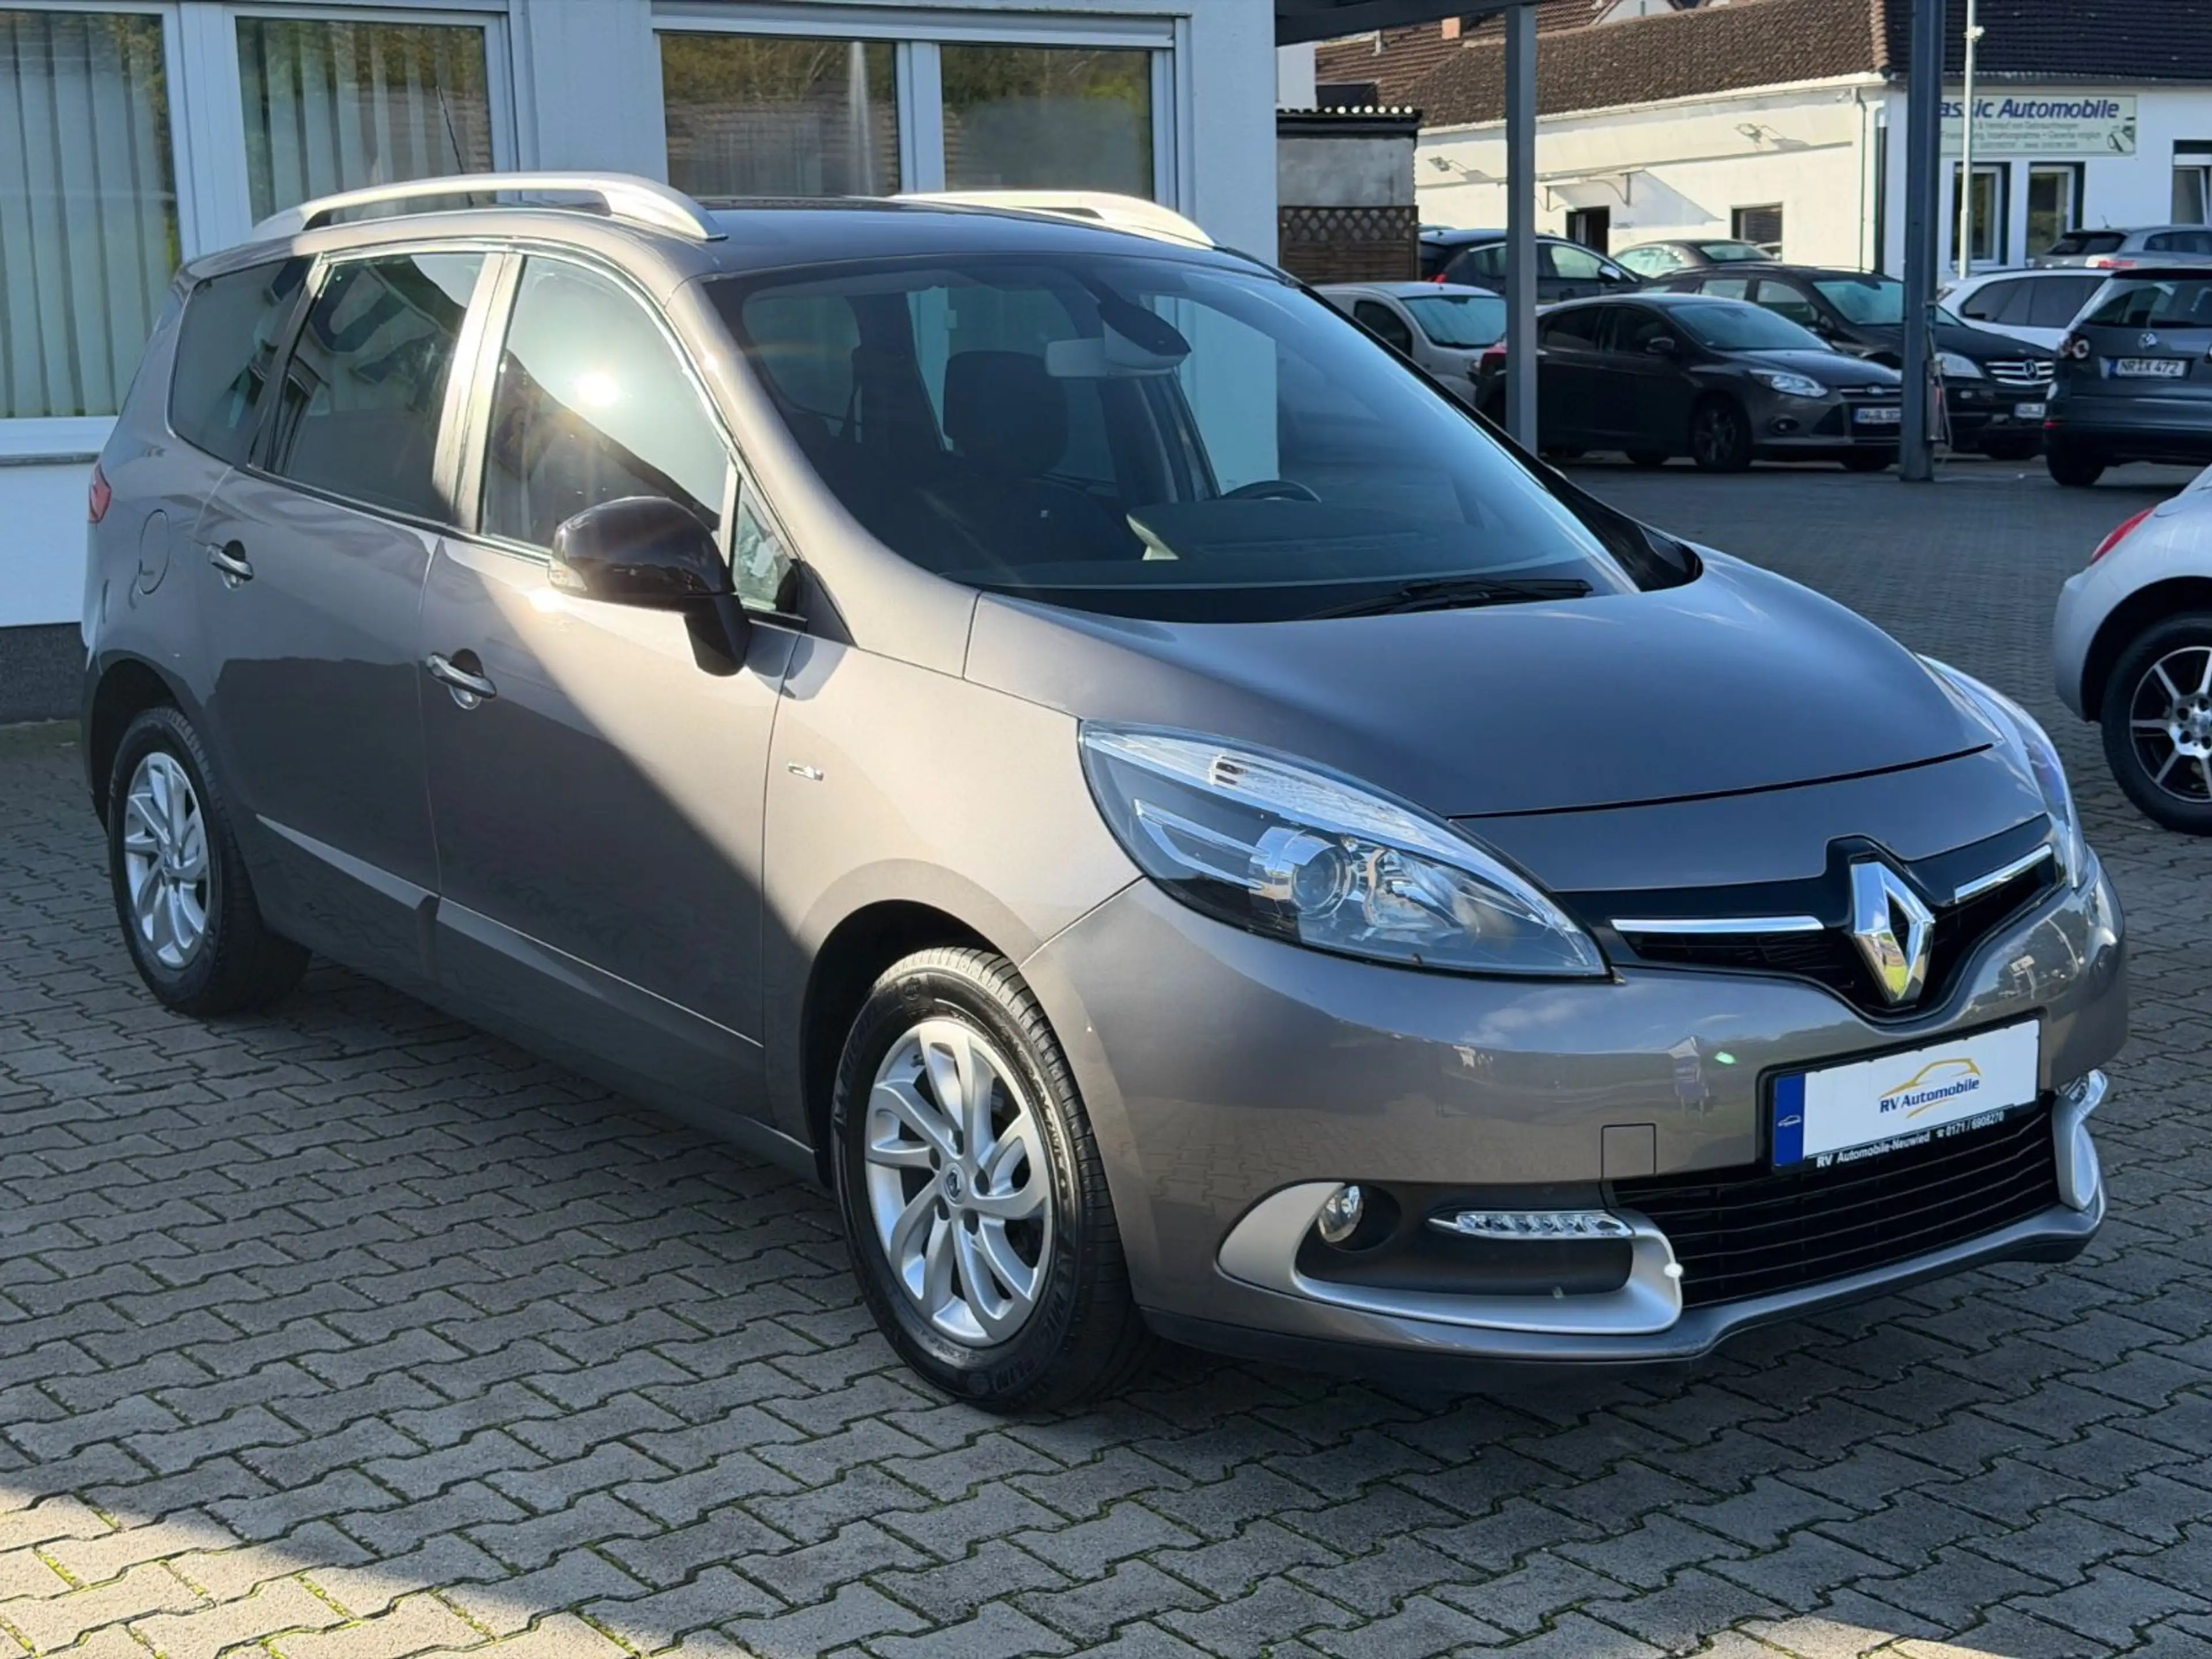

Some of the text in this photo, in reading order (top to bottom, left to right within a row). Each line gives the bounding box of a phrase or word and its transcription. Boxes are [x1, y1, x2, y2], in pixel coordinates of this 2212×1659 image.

[1997, 99, 2119, 119] Automobile
[1880, 1078, 1980, 1113] RV Automobile
[1816, 1154, 1833, 1168] RV
